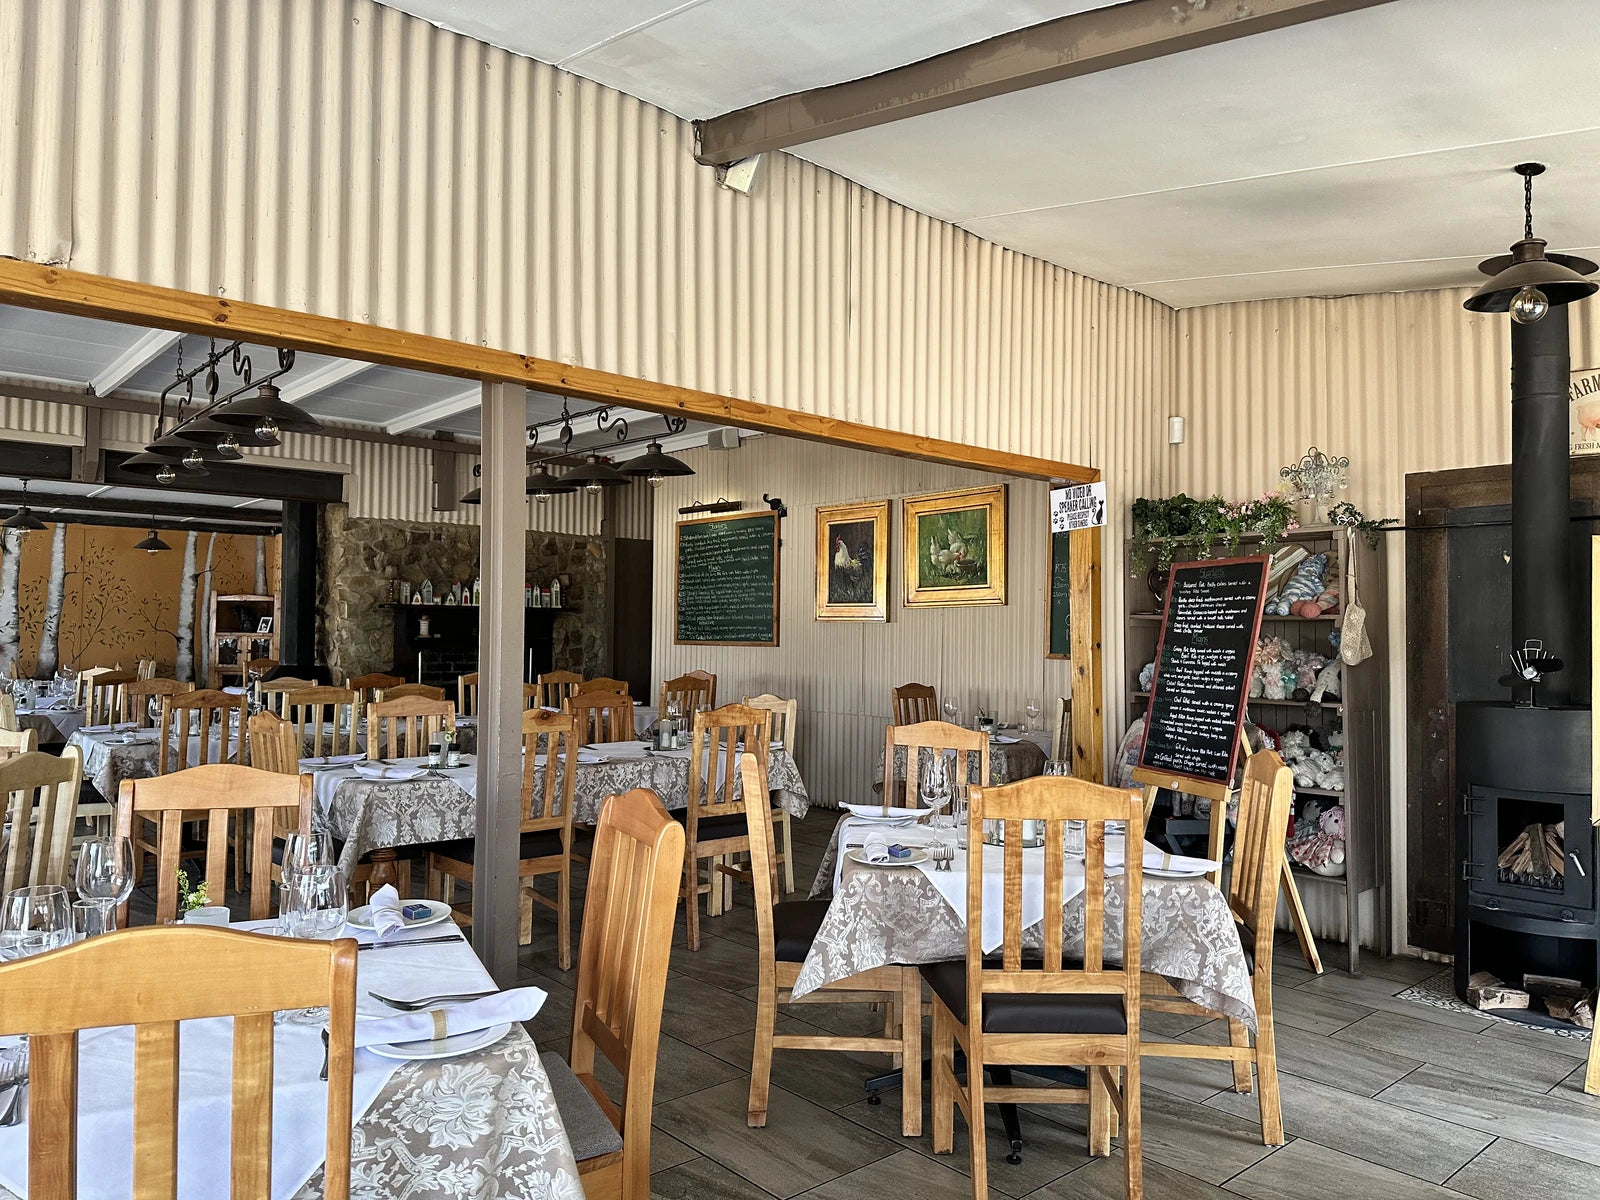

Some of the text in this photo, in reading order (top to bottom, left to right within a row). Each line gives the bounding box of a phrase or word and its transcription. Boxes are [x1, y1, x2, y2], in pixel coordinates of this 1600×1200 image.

[1575, 442, 1594, 450] FRESH
[1065, 484, 1092, 500] NO VIDEO OR
[1059, 495, 1097, 514] SPEAKER CALLING
